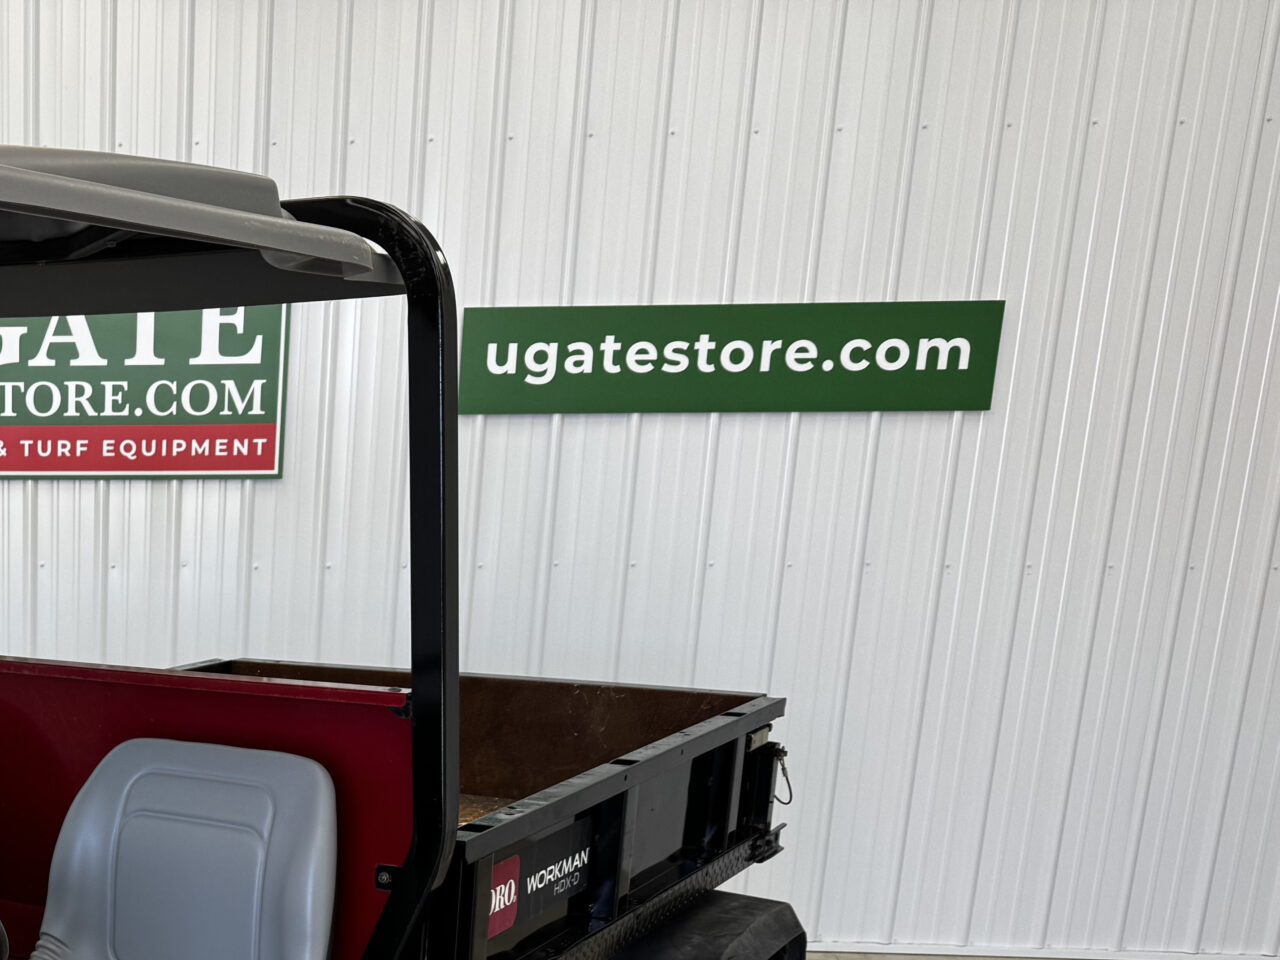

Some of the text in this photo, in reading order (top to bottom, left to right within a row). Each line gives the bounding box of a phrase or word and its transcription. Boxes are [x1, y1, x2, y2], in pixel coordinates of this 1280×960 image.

[485, 333, 972, 385] ugatestore.com
[19, 439, 89, 457] TURF
[102, 437, 268, 460] EQUIPMENT
[526, 847, 590, 895] WORKMAN
[553, 871, 580, 896] HDX-D
